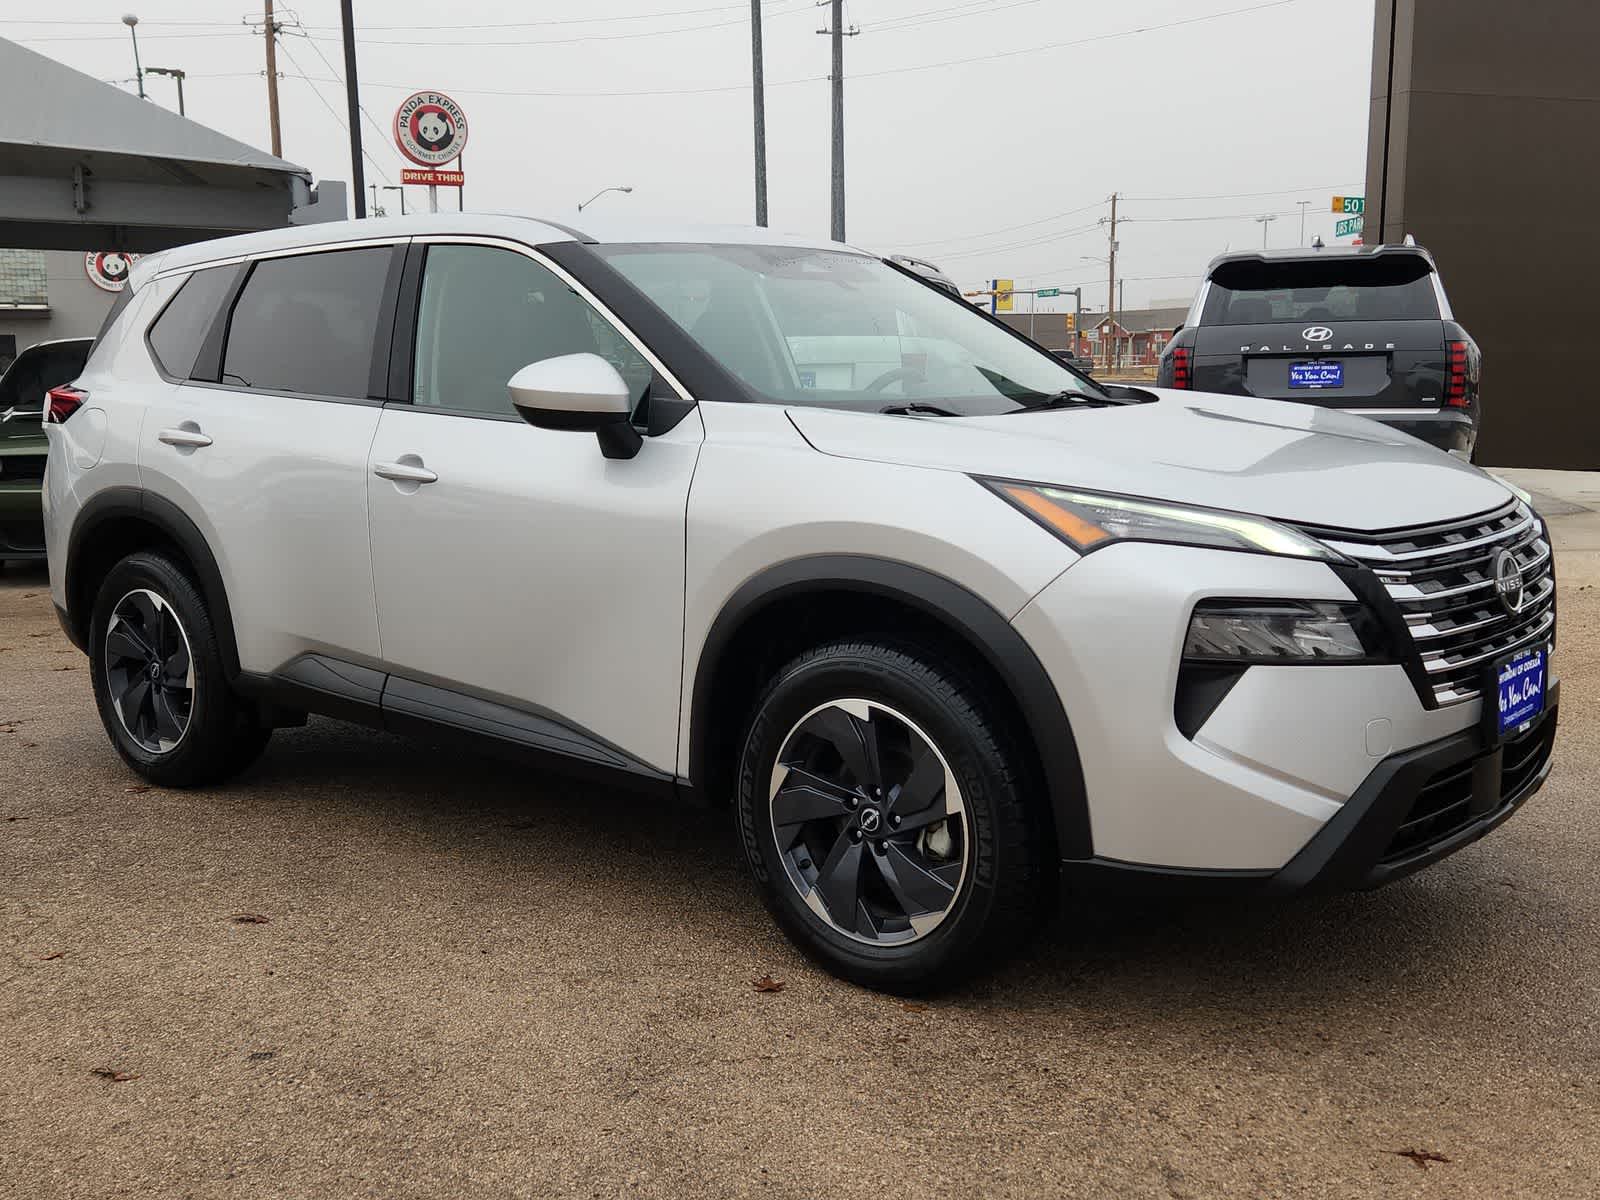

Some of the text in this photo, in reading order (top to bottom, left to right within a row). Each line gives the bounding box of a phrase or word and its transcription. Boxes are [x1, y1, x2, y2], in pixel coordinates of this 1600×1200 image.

[399, 95, 465, 129] PANDA EXPRESS
[403, 172, 464, 182] DRIVE THRU
[1240, 343, 1395, 352] PALISADE
[1291, 370, 1340, 380] Yes You Can!
[1497, 578, 1521, 592] NISS
[1508, 684, 1522, 709] You
[1522, 670, 1543, 701] Can!
